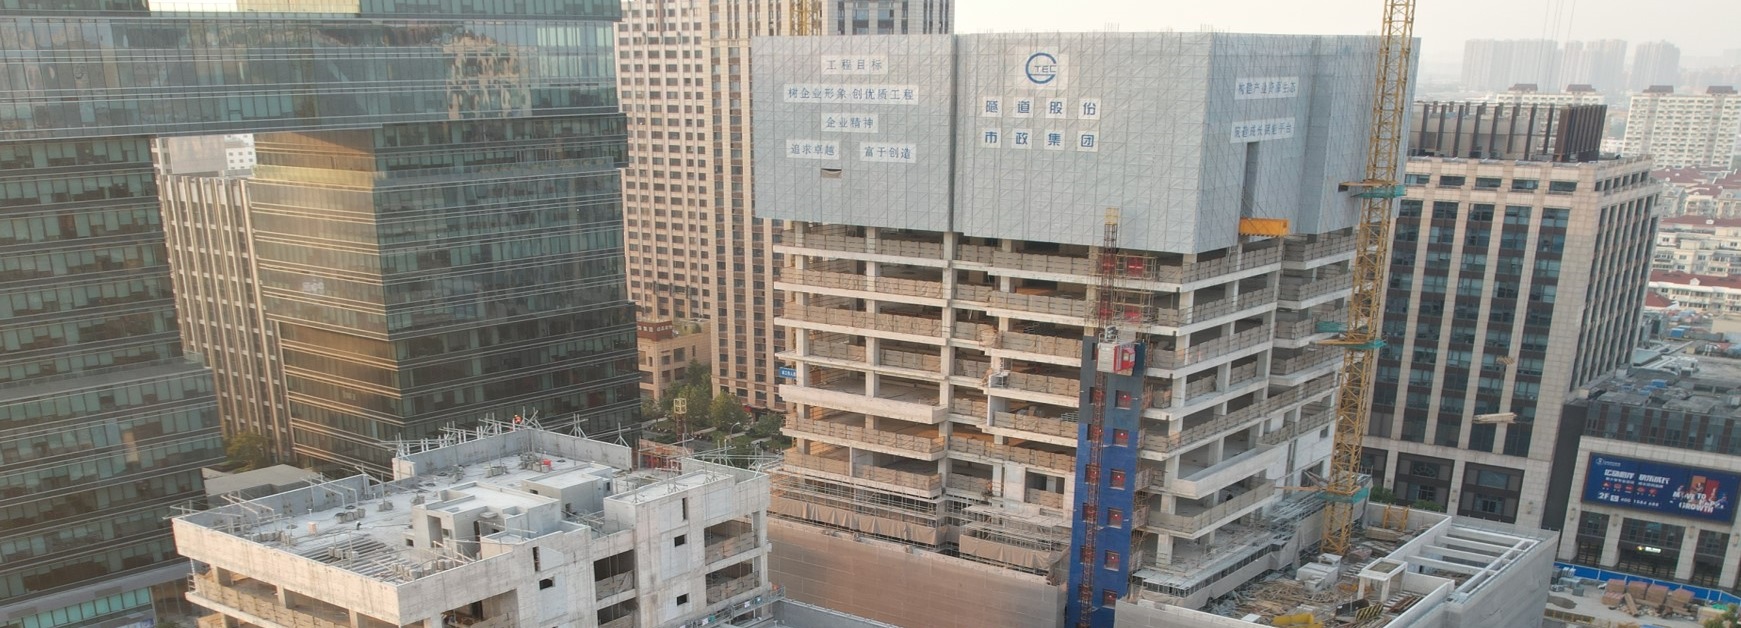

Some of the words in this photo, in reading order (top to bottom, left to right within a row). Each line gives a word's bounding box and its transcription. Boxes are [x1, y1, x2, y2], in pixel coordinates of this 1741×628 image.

[826, 59, 882, 70] 工程目标
[985, 100, 1096, 116] 隧道股份
[825, 116, 874, 129] 企业精神
[985, 131, 1095, 147] 市政集团
[791, 144, 835, 156] 追求卓越
[865, 145, 911, 159] 富于创造
